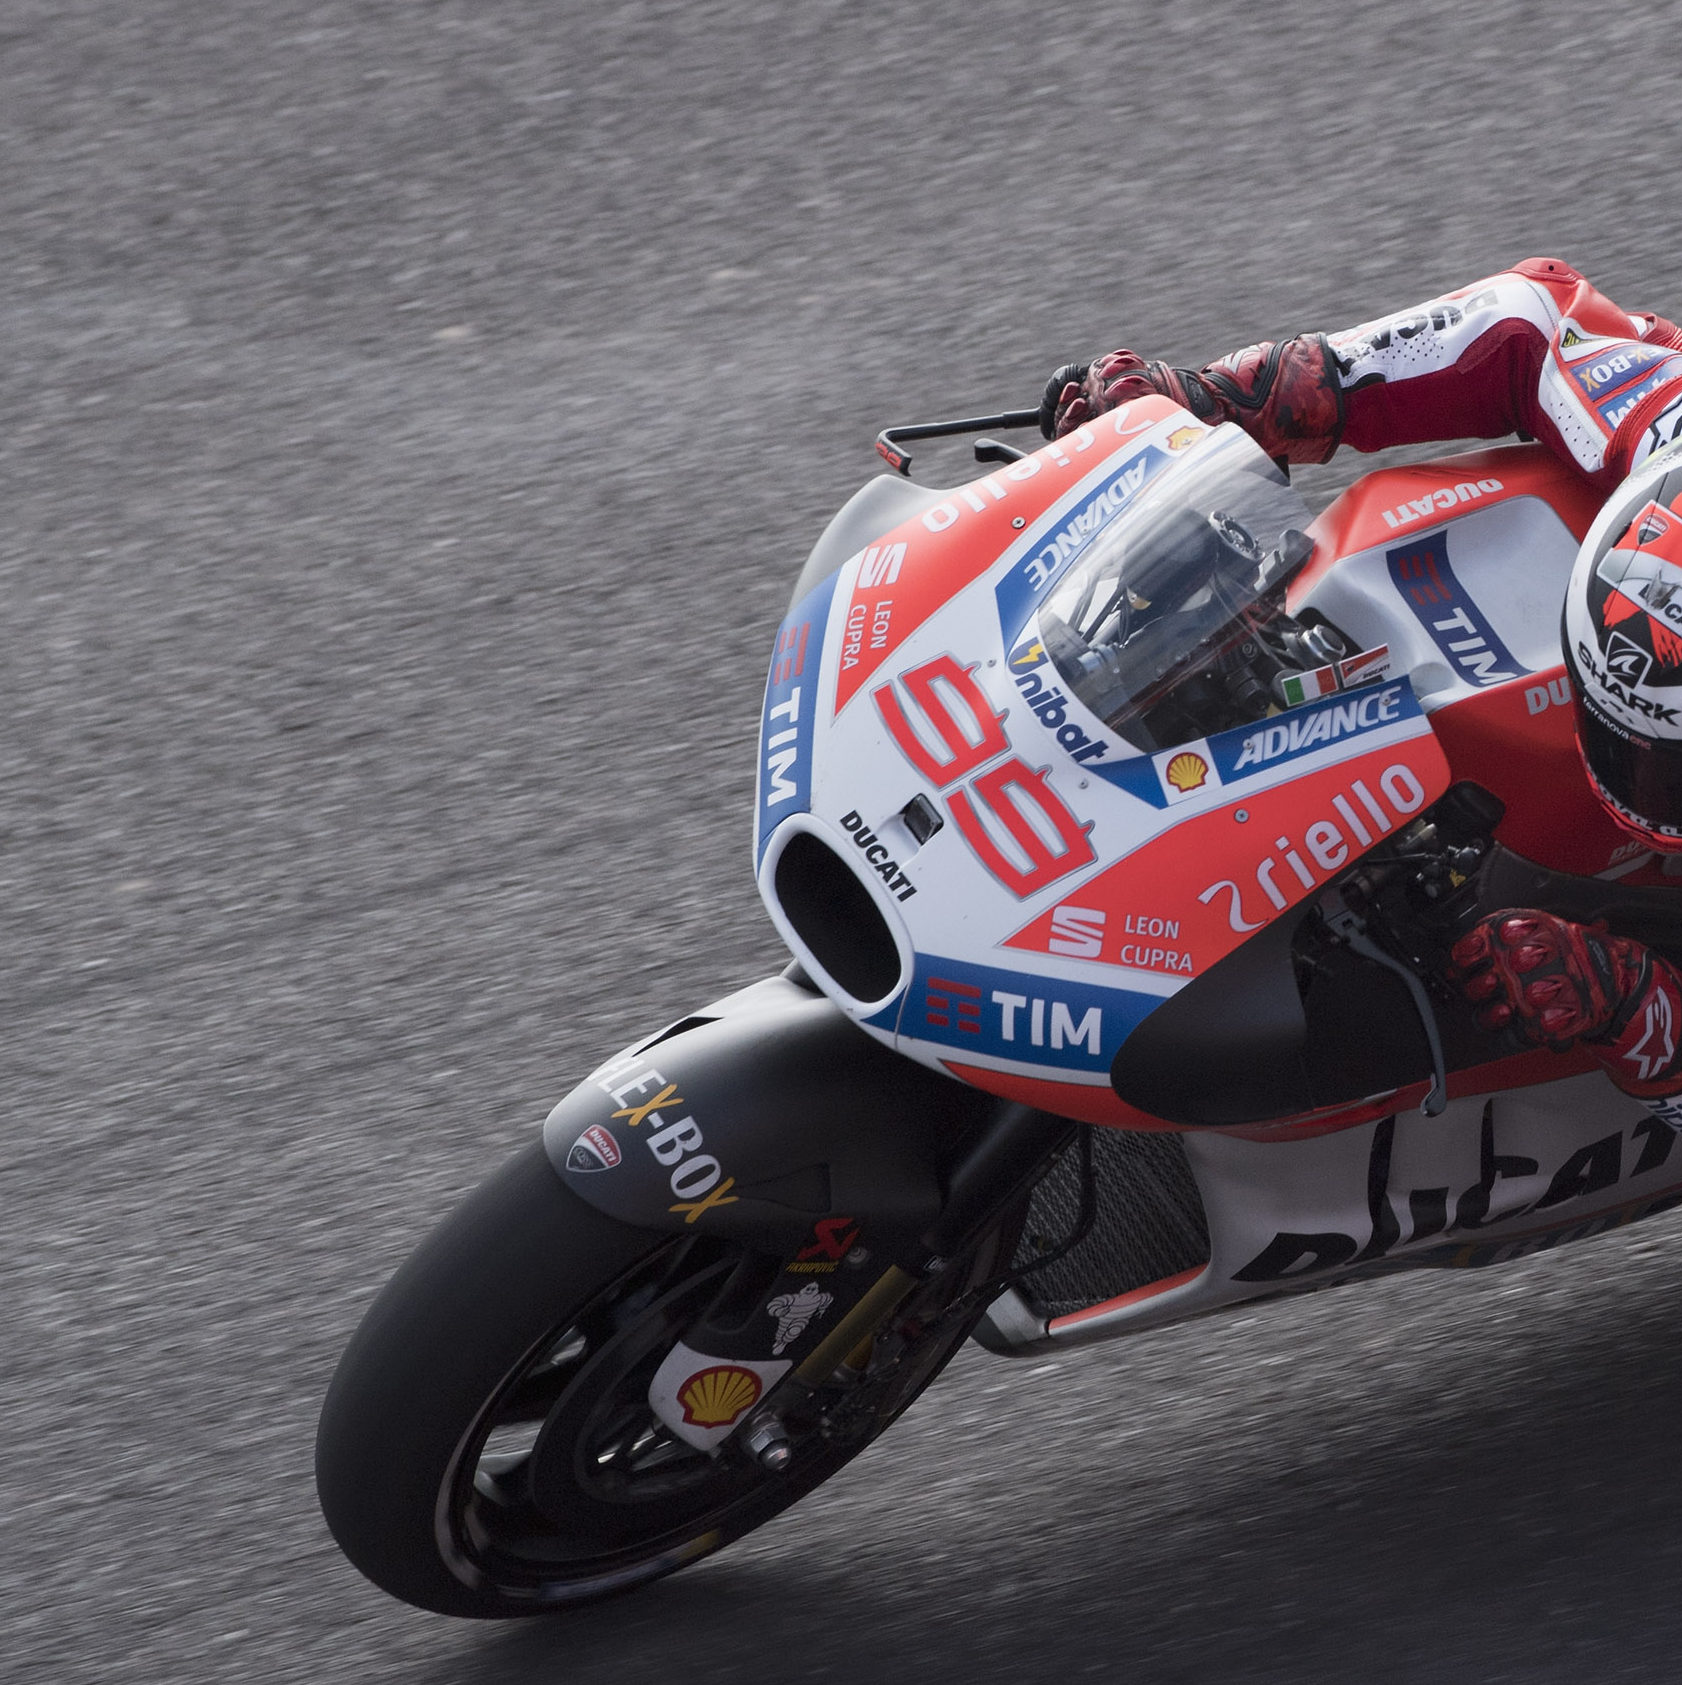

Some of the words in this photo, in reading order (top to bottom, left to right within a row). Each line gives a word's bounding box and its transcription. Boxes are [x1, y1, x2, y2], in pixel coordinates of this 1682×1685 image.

[921, 425, 1096, 533] riello
[1382, 477, 1504, 530] DUCATI
[1023, 456, 1146, 591] ADVANCE
[841, 605, 867, 670] CUPRA
[871, 600, 893, 650] LEON
[1433, 607, 1518, 686] TIM
[1578, 641, 1682, 727] SHARK
[766, 686, 802, 807] TIM
[1234, 686, 1402, 772] ADVANCE
[870, 652, 1098, 899] 99
[840, 811, 918, 901] DUCATI
[1256, 764, 1425, 911] riello
[1120, 945, 1193, 973] CUPRA
[1125, 914, 1180, 940] LEON
[992, 990, 1102, 1056] TIM
[590, 1129, 617, 1162] DUCATI
